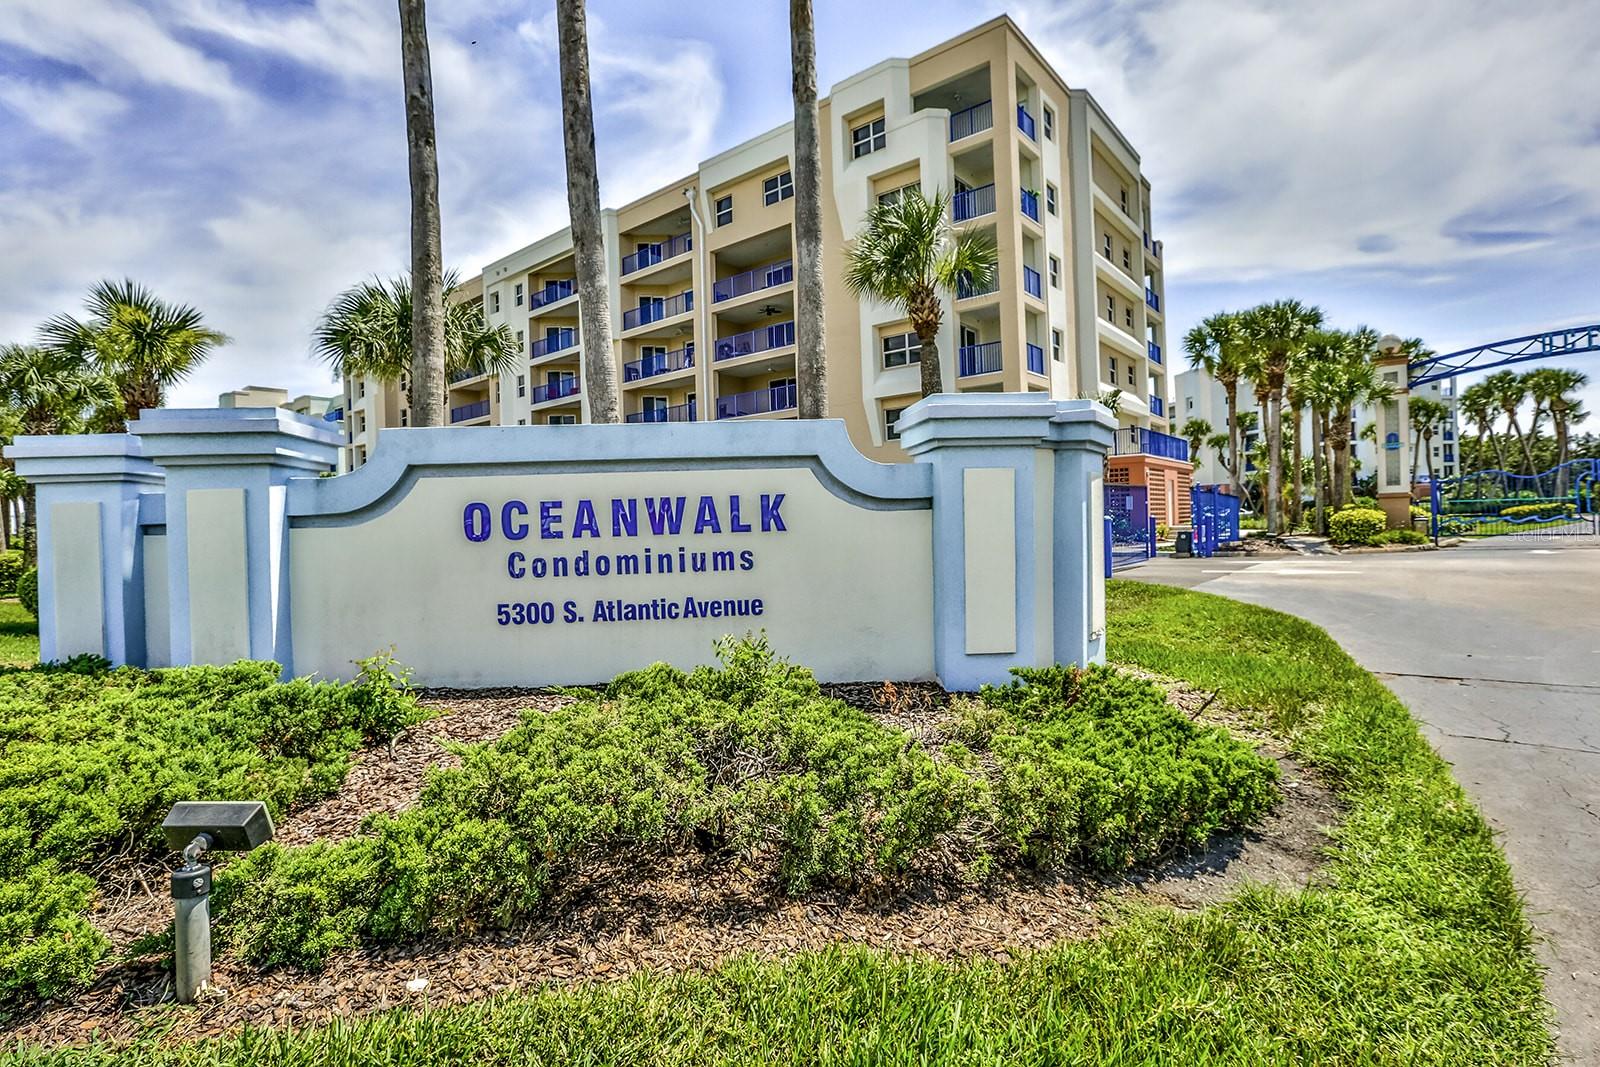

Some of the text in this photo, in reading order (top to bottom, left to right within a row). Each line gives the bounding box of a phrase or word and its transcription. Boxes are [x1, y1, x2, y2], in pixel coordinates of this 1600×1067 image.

[463, 493, 788, 543] OCEANWALK
[507, 547, 754, 579] Condominiums
[497, 596, 764, 626] 5300 S. Atlantic Avenue
